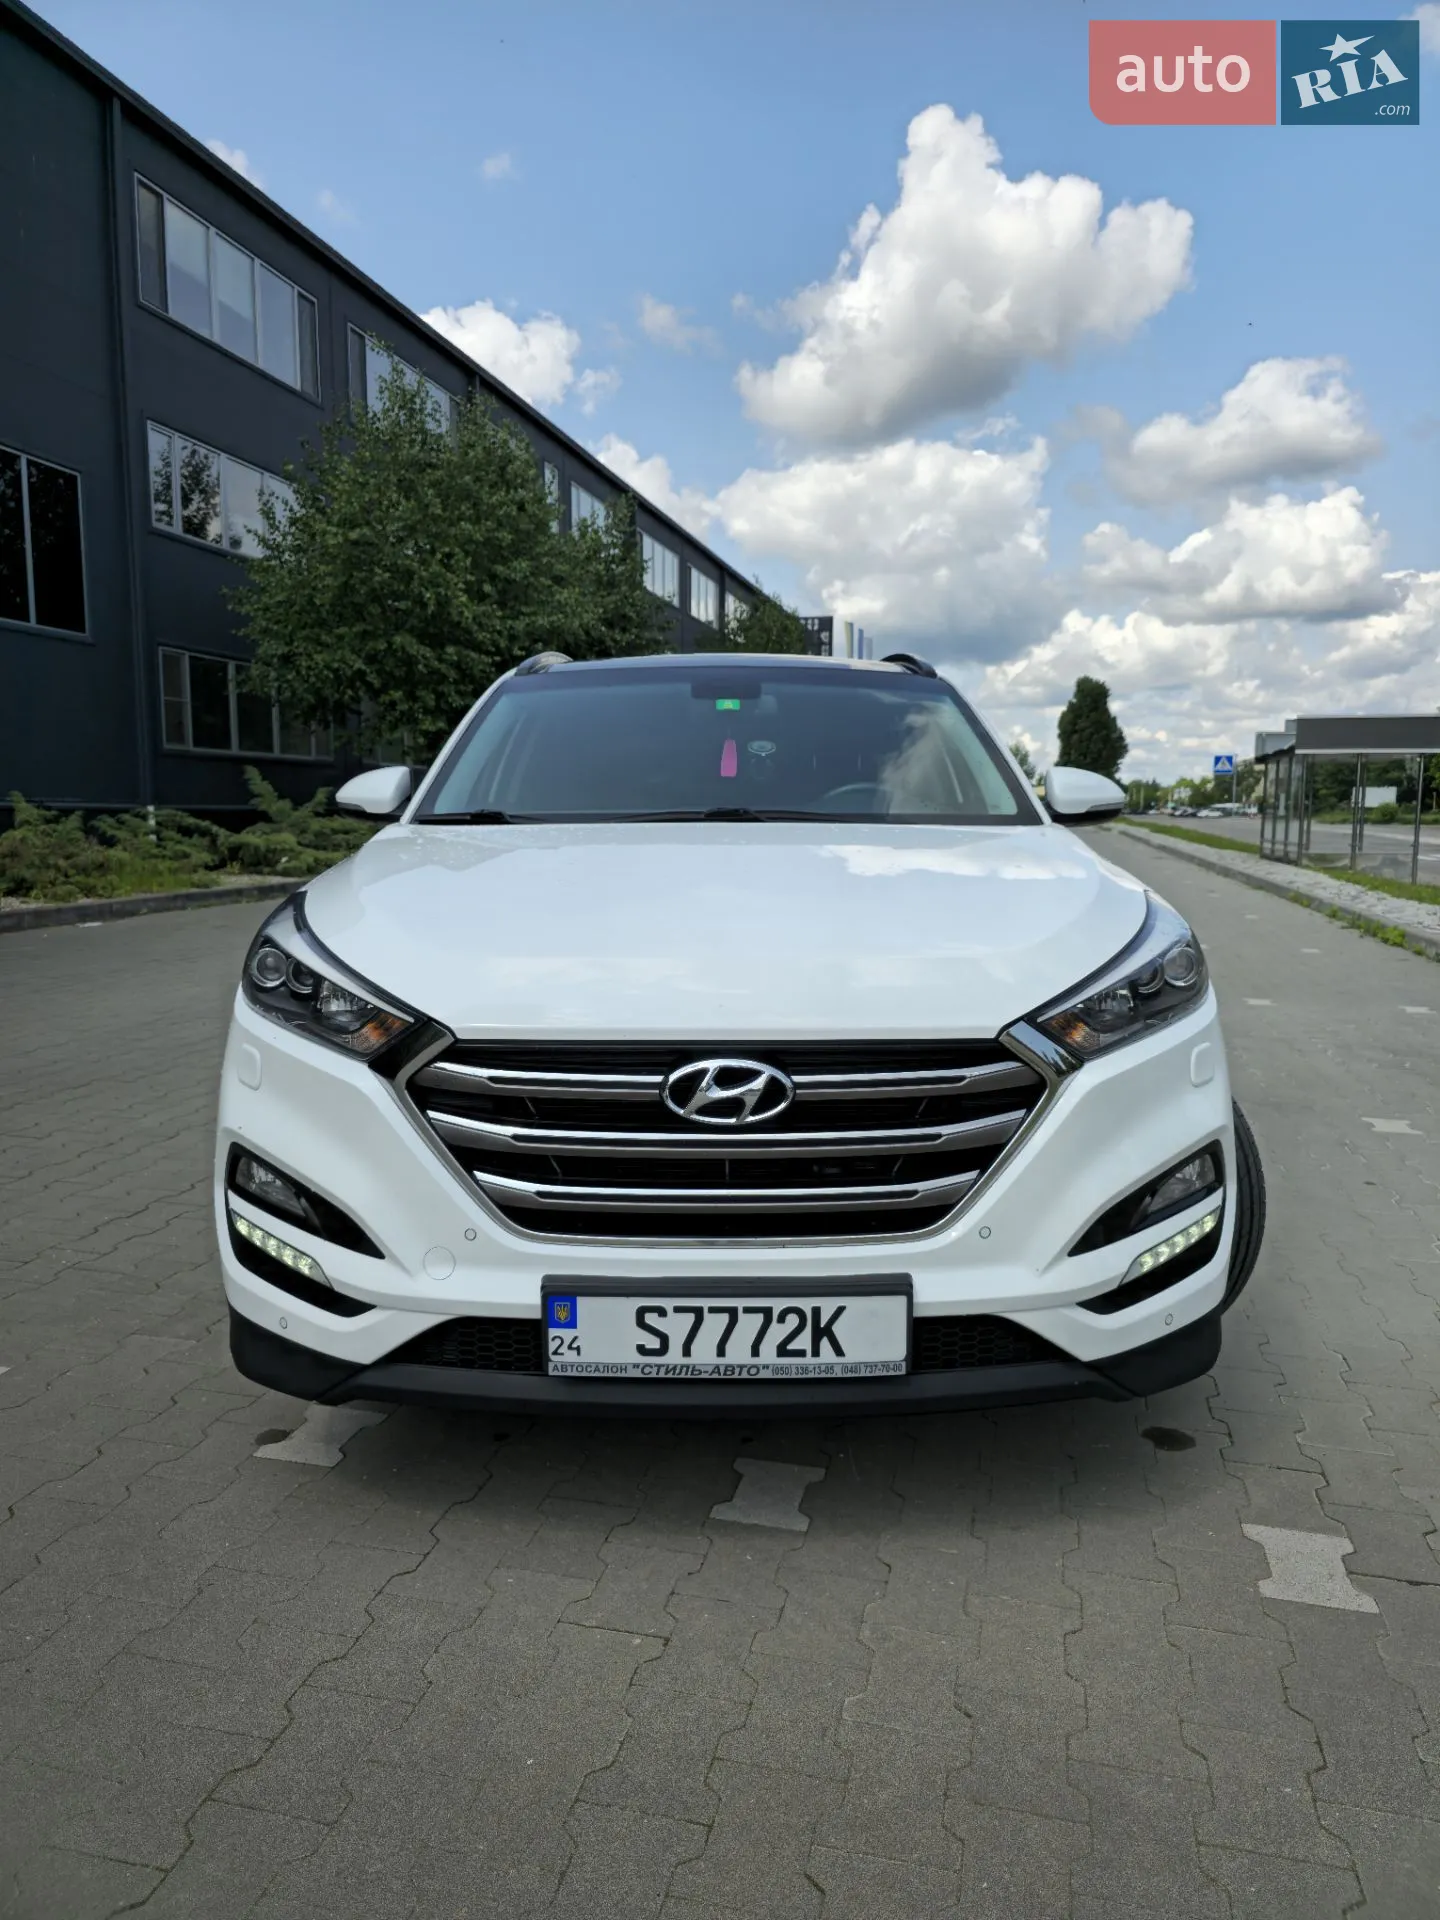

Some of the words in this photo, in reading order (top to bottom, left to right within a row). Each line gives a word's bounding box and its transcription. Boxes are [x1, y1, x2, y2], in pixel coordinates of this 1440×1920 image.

[635, 1305, 847, 1358] S7772K
[551, 1335, 581, 1357] 24
[552, 1363, 628, 1374] АВТОСАЛОН
[632, 1364, 770, 1377] "СТИЛЬ-АВТО"
